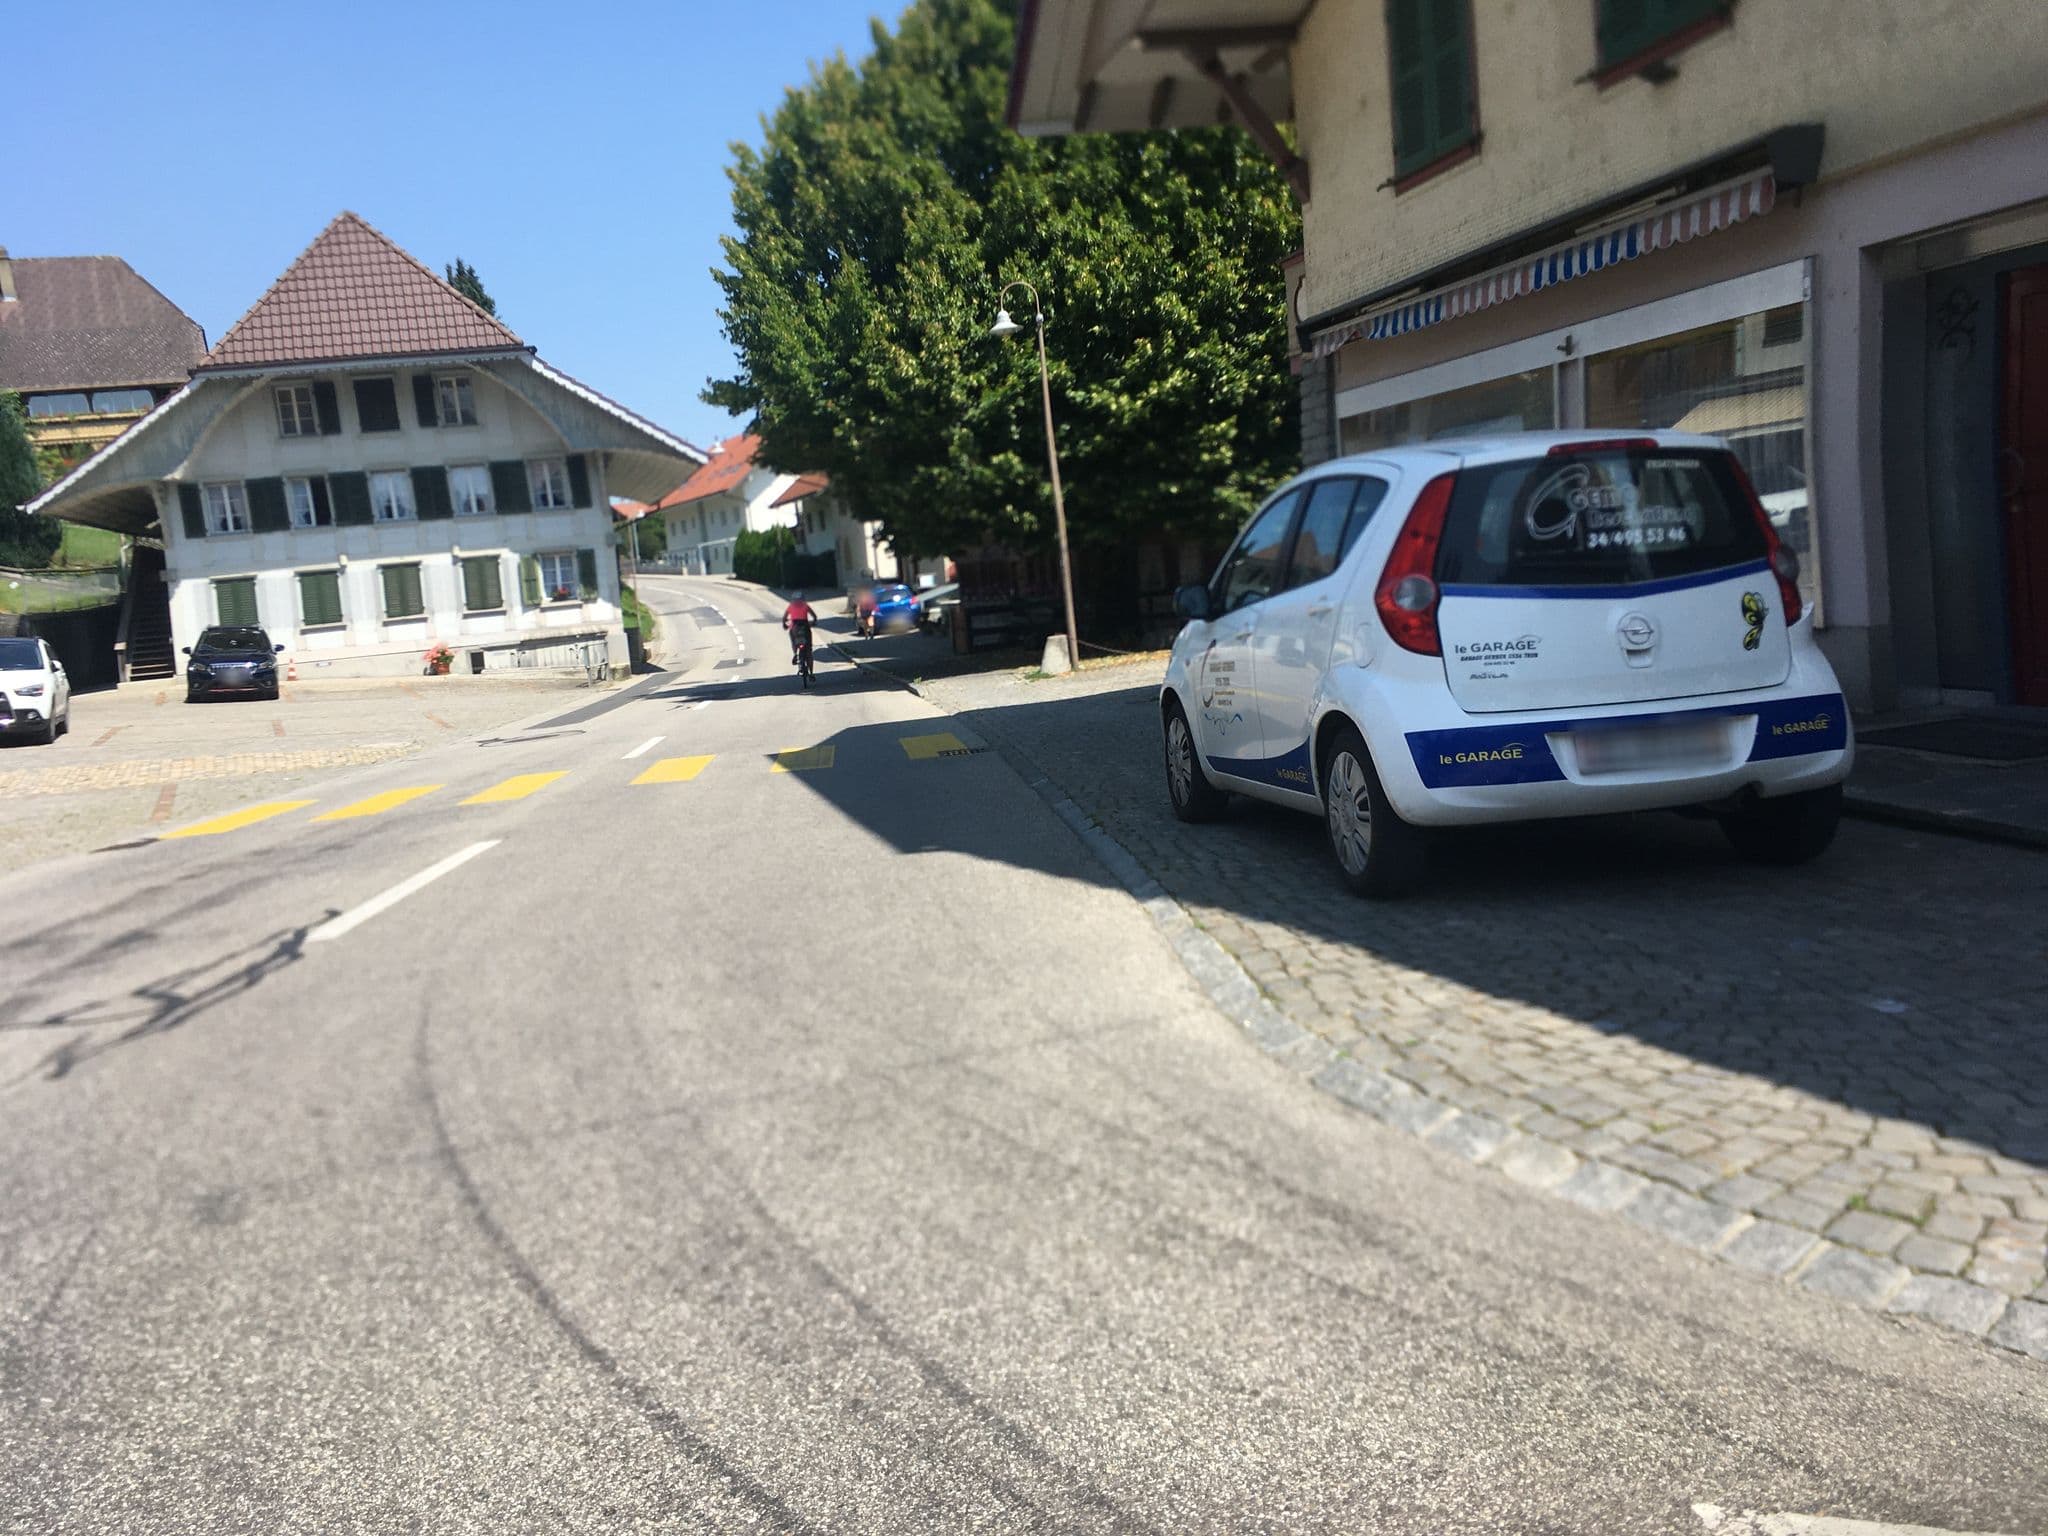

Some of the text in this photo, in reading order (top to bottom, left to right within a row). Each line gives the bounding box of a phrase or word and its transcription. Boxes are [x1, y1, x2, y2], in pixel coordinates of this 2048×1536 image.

[1455, 640, 1536, 653] le GARAGE
[1772, 719, 1829, 736] le GARAGE
[1440, 749, 1523, 764] le GARAGE
